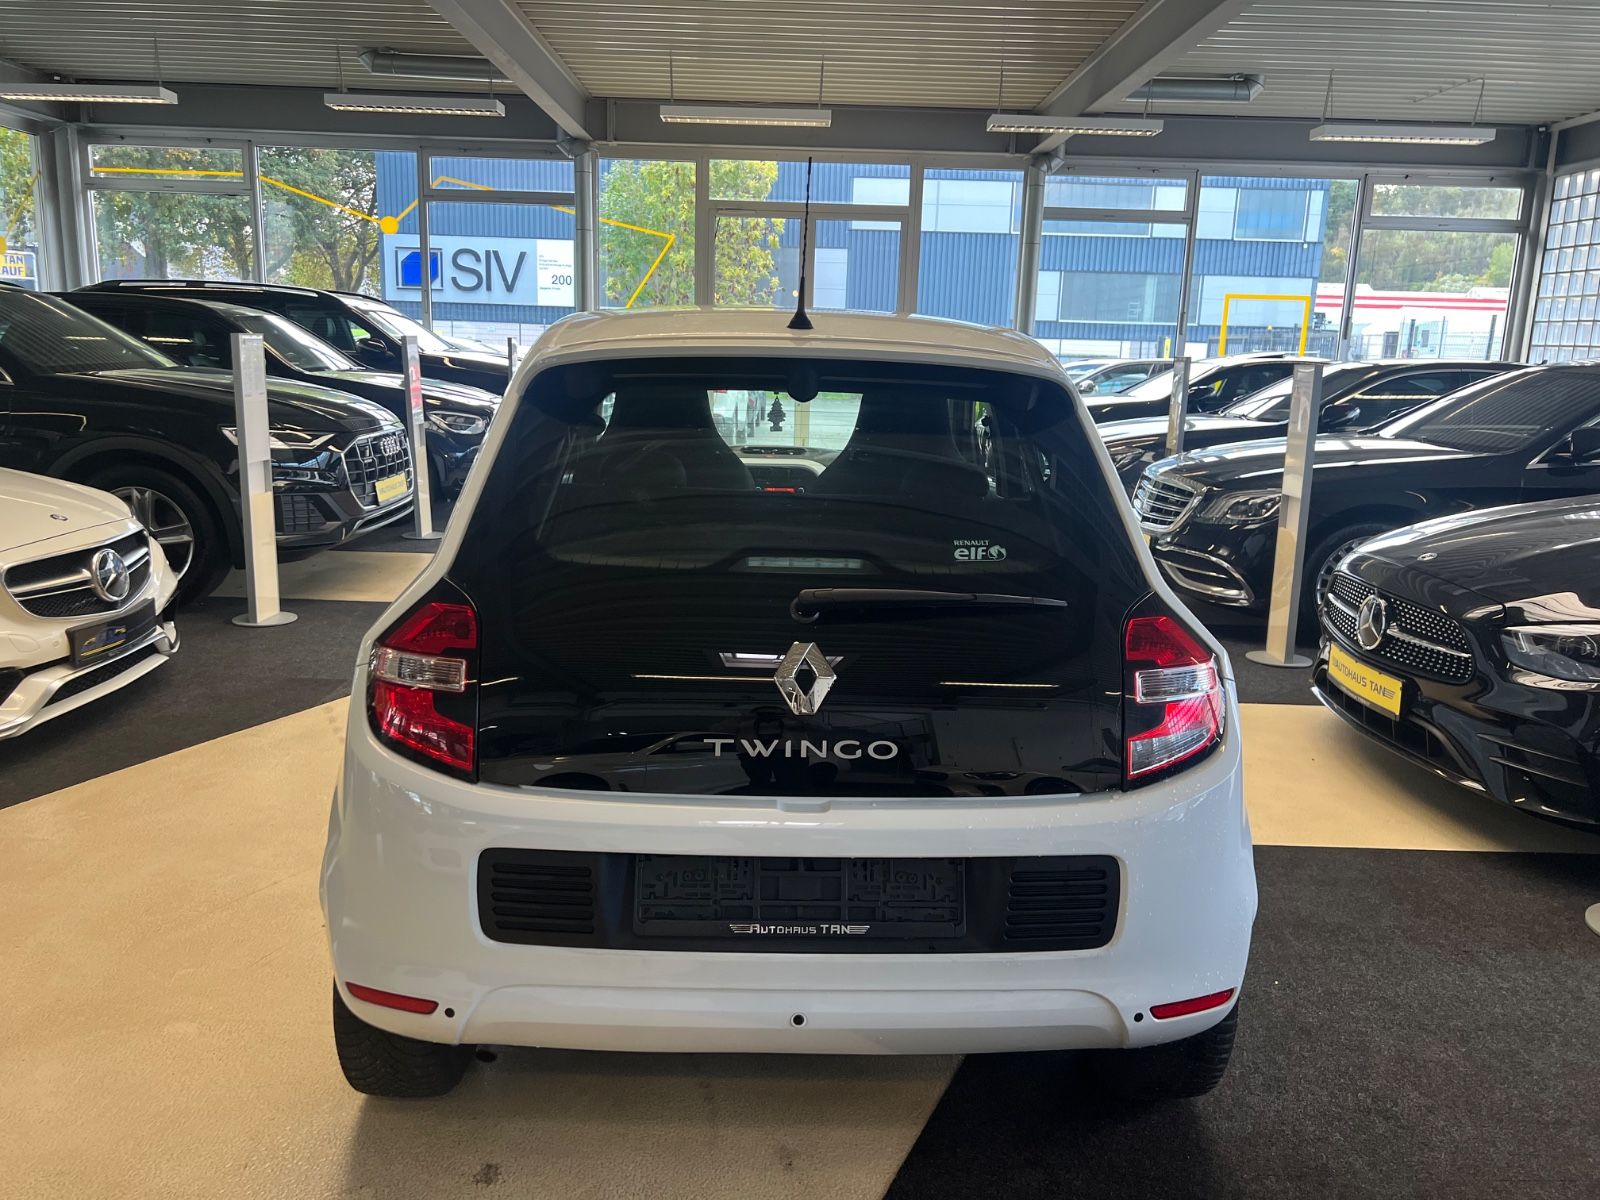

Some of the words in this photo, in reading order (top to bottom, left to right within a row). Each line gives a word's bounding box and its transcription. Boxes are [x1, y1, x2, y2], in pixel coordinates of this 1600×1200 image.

[4, 255, 24, 265] TAN
[451, 248, 527, 293] SIV
[551, 274, 572, 286] 200
[953, 546, 987, 560] elf
[1334, 659, 1367, 688] AUTOHAUS
[1369, 680, 1386, 697] TAN
[703, 738, 899, 760] TWINGO
[820, 924, 851, 935] TAN
